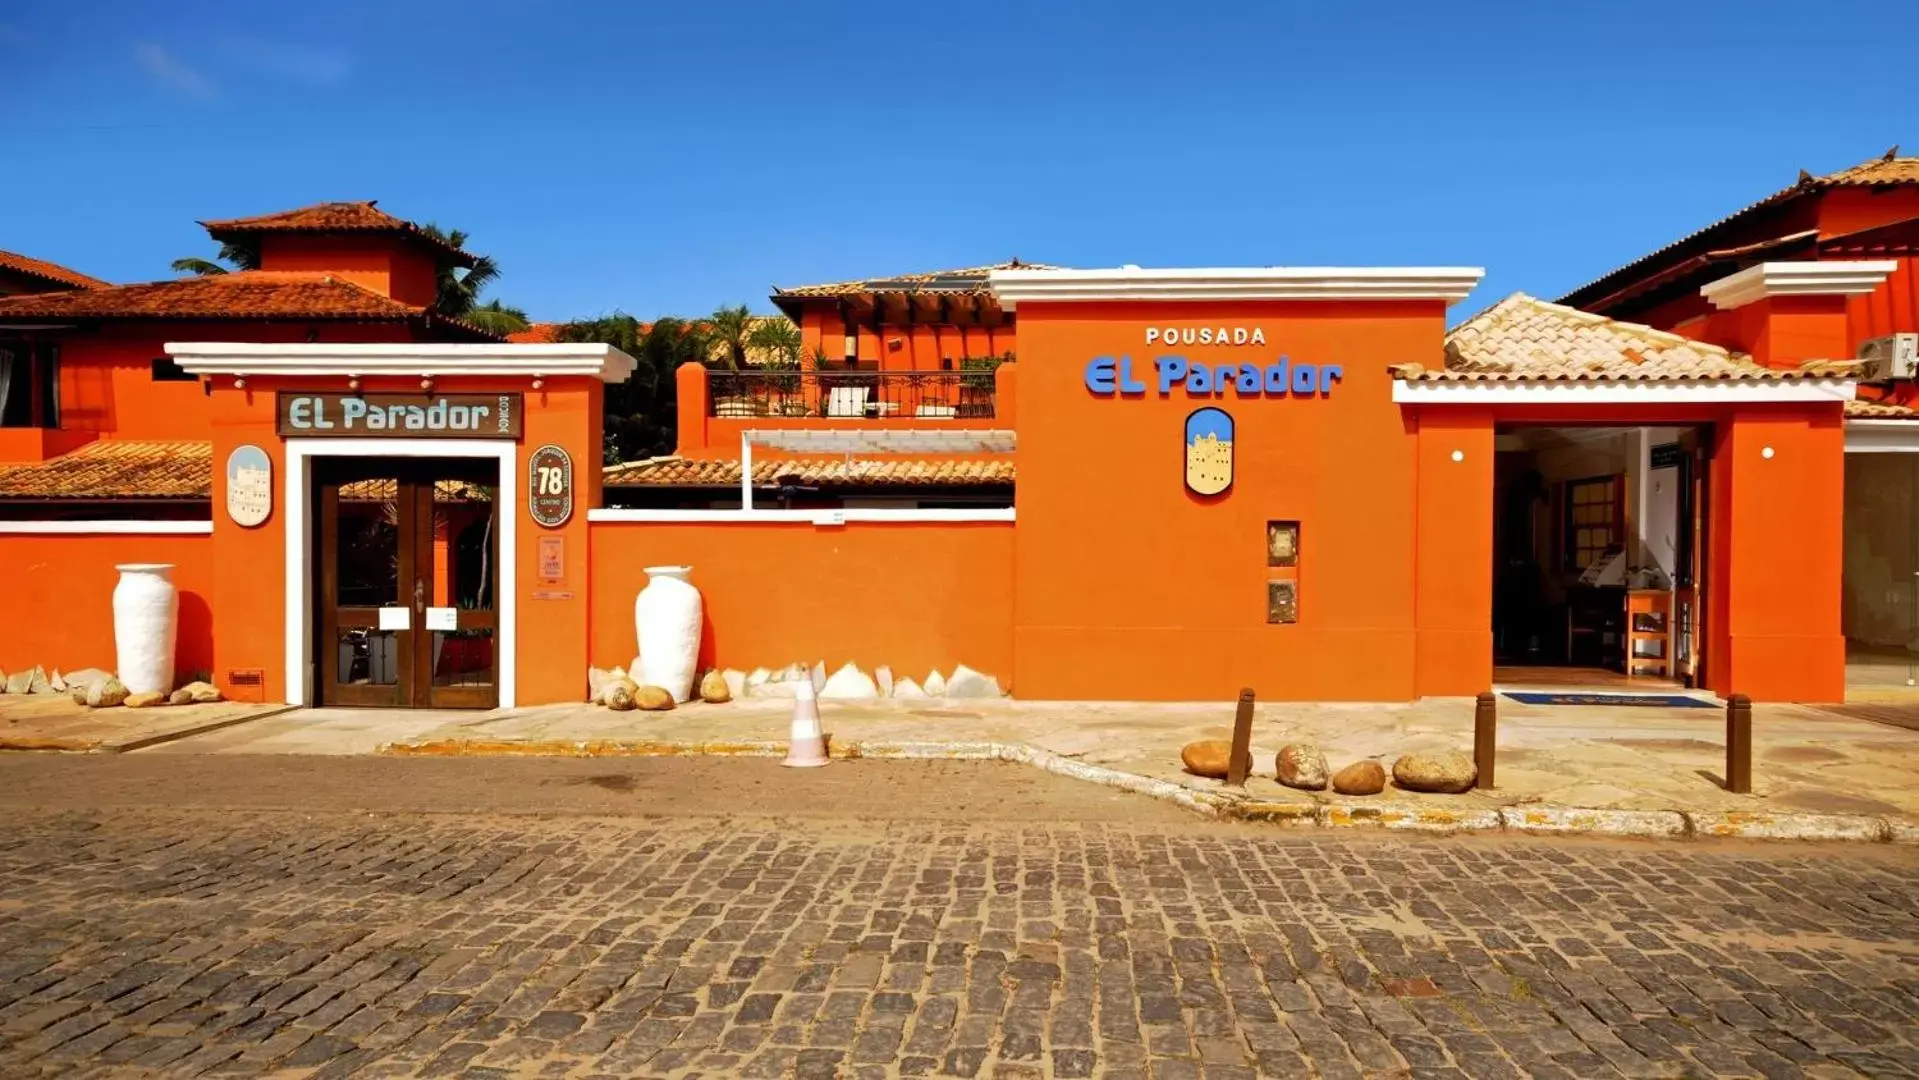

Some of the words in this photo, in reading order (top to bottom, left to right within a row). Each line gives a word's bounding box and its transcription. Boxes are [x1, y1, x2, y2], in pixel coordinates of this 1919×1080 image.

[1145, 327, 1266, 345] POUSADA
[1085, 354, 1146, 394] EL
[1155, 353, 1343, 394] Parador
[289, 397, 334, 429] EL
[340, 397, 489, 430] Parador
[537, 466, 563, 495] 78
